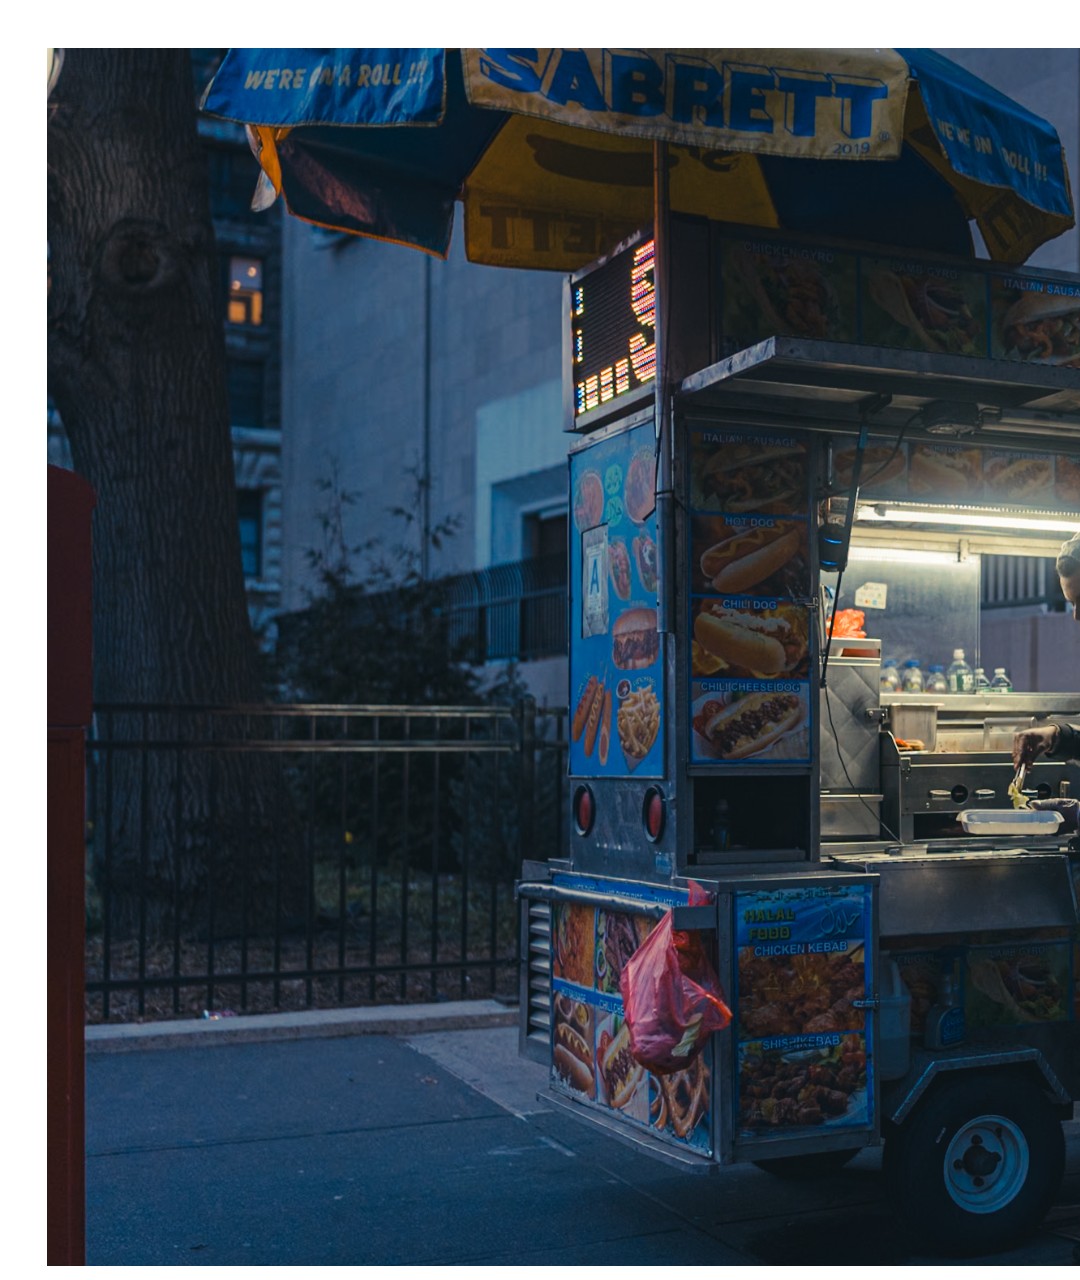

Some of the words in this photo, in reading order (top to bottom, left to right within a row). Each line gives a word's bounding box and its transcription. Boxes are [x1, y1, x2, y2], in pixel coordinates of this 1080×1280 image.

[243, 67, 307, 91] WE'RE
[356, 62, 401, 87] ROLL
[480, 48, 888, 139] SABRETT
[832, 142, 871, 156] 2019
[1003, 278, 1044, 293] ITALIAN
[725, 516, 747, 526] HOT
[750, 517, 775, 527] DOG
[588, 564, 600, 597] A
[722, 599, 750, 609] CHILI
[753, 600, 777, 610] DOG
[702, 682, 728, 691] CHILI
[731, 682, 773, 692] CHEESE
[776, 683, 801, 692] DOG
[745, 908, 795, 923] HALAL
[749, 926, 791, 941] FOOD
[754, 943, 806, 957] CHICKEN
[808, 941, 848, 954] KEBAB
